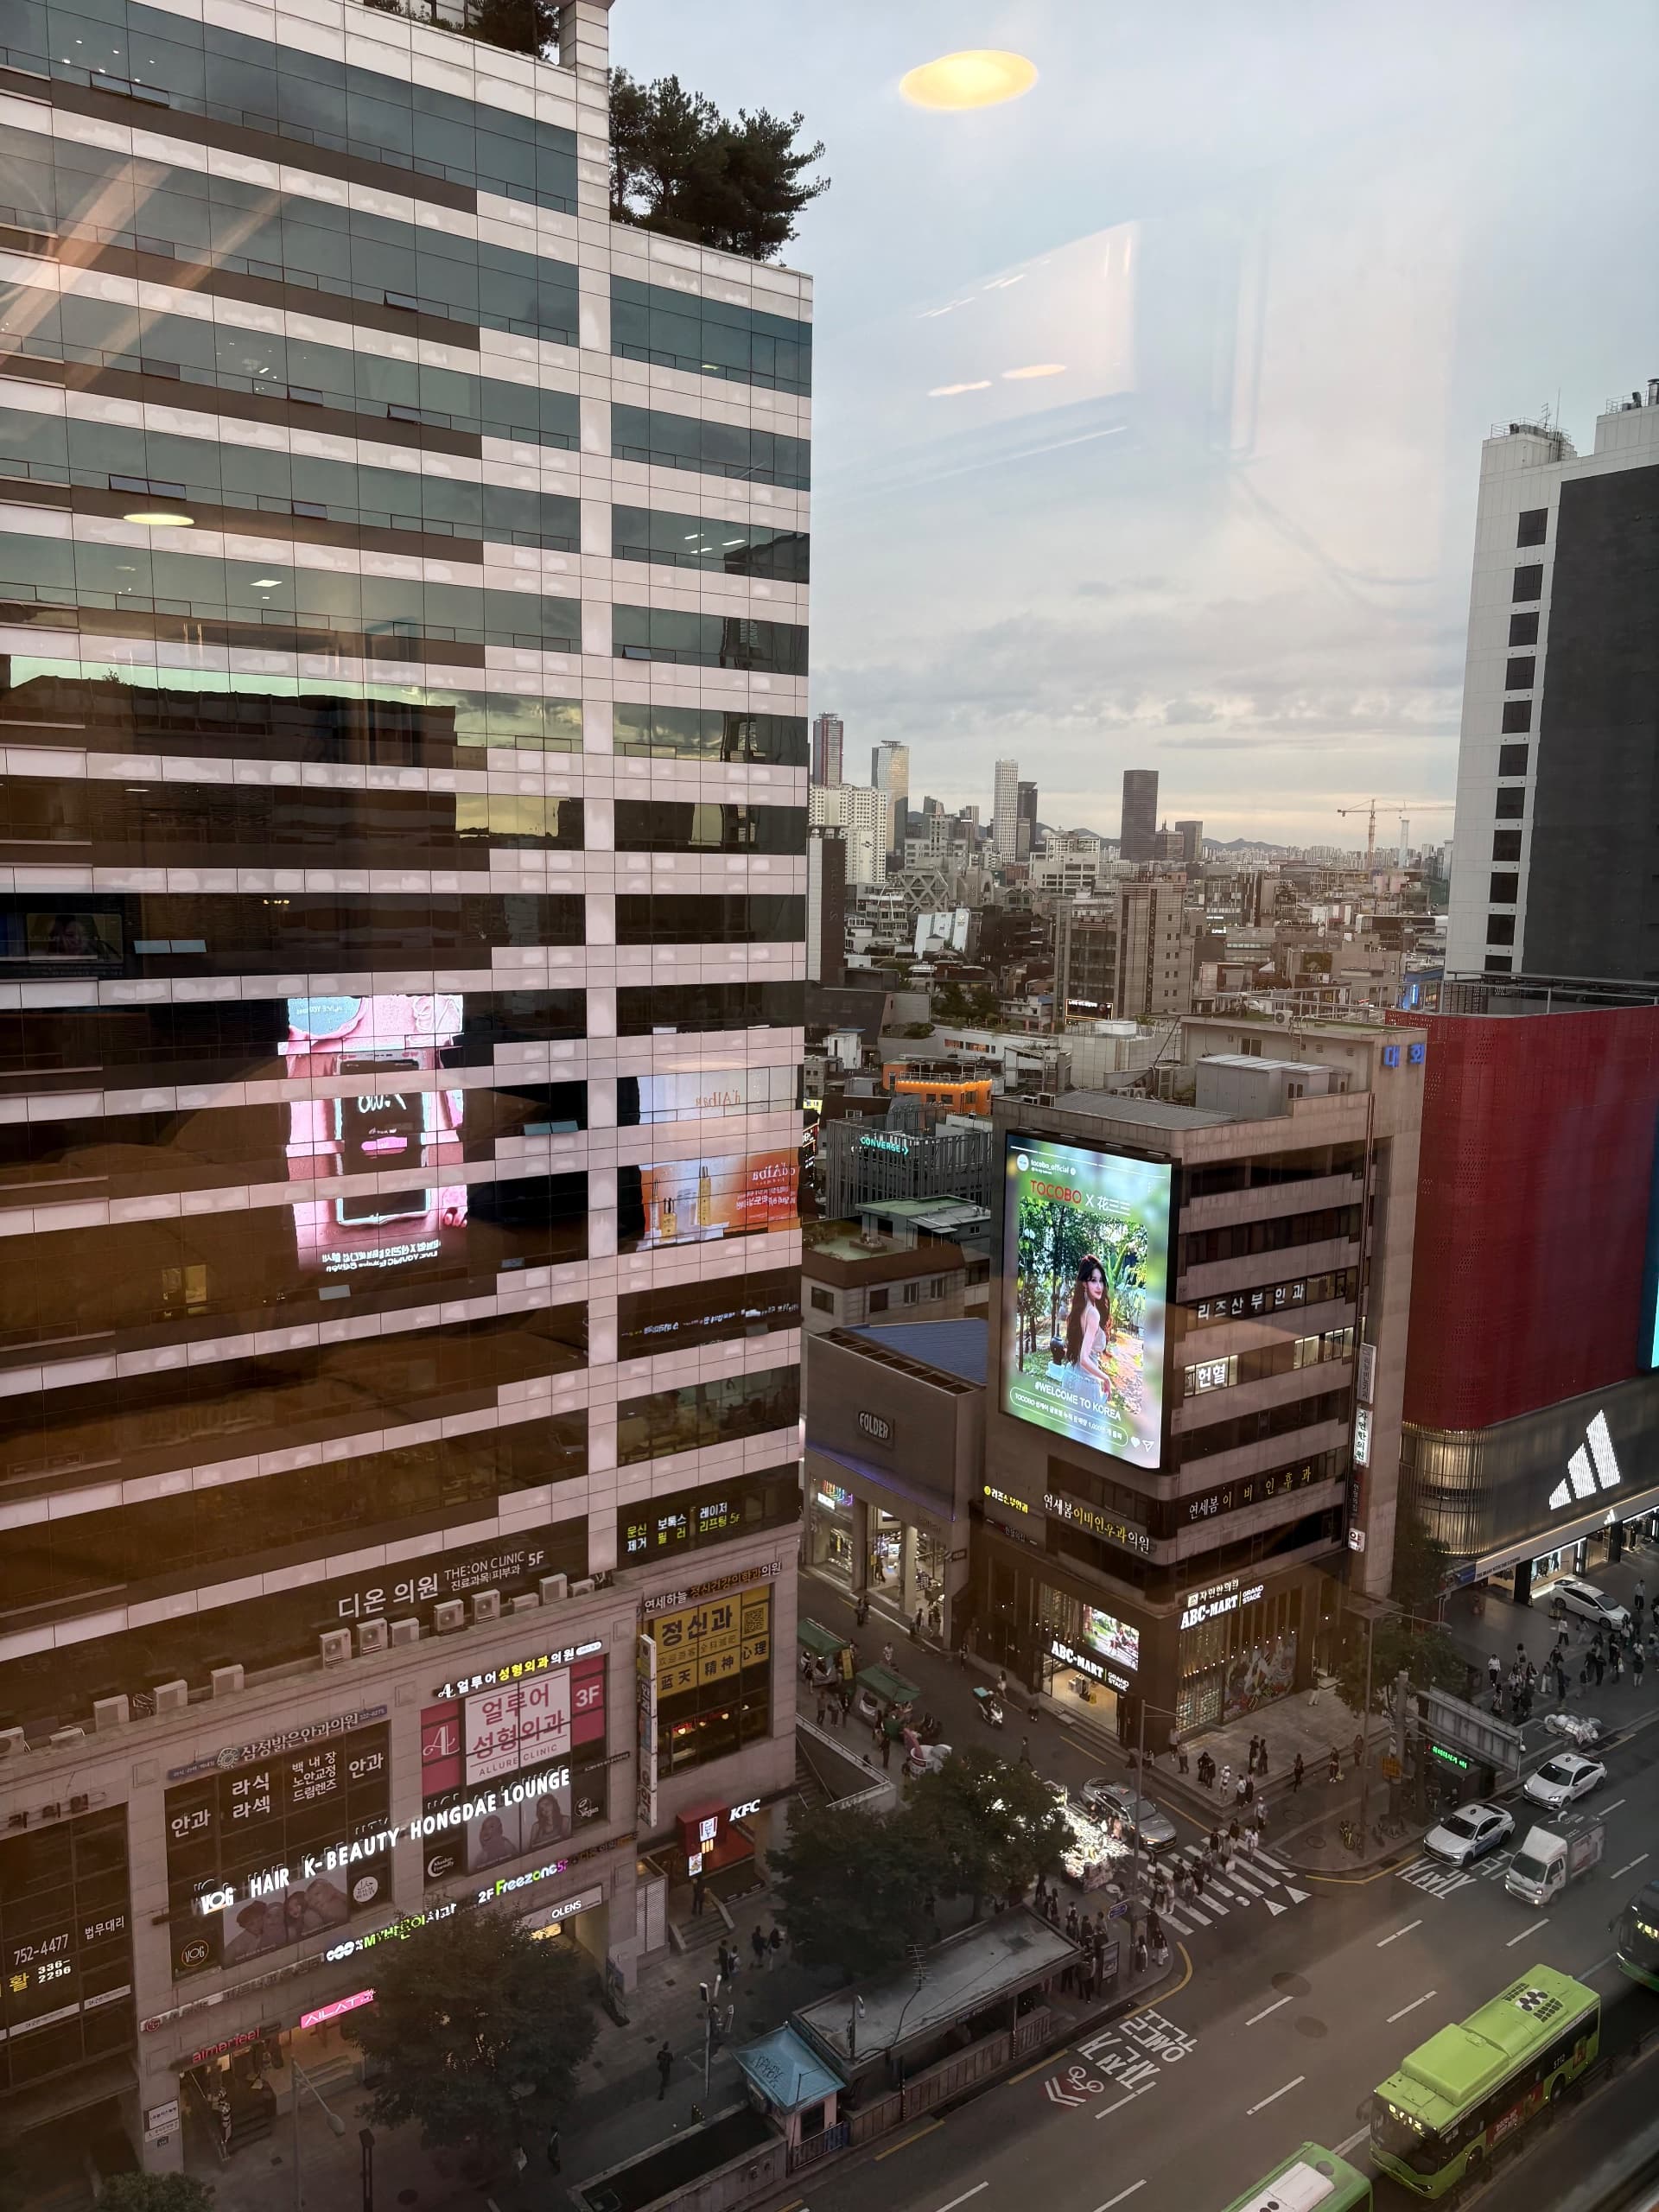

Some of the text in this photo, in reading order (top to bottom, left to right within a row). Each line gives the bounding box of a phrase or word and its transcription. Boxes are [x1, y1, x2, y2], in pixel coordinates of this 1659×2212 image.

[860, 1135, 901, 1153] CONVERSE
[1030, 1179, 1082, 1205] TOCOBO
[1084, 1193, 1095, 1208] X
[1197, 1283, 1306, 1322] 리즈산부인과
[1198, 1363, 1227, 1387] 헌혈
[1079, 1396, 1091, 1409] TO
[1091, 1402, 1122, 1421] KOREA
[858, 1411, 889, 1439] FOLDER
[1188, 1465, 1312, 1521] 연세봄 이비인후과
[658, 1514, 687, 1530] 보톡스
[700, 1503, 728, 1518] 레이저
[1044, 1492, 1150, 1554] 연세봄이비인후과의원
[626, 1523, 647, 1539] 문신
[699, 1516, 728, 1533] 리프팅
[626, 1537, 647, 1553] 제거
[443, 1550, 545, 1581] THE:ON CLINIC 5F
[492, 1564, 522, 1580] 피부과
[338, 1573, 439, 1618] 디온 의원
[644, 1590, 688, 1612] 연세하늘
[1242, 1592, 1262, 1605] STAGE
[1243, 1585, 1264, 1598] GRAND
[1179, 1594, 1238, 1630] ABC-MART
[662, 1604, 733, 1647] 정신과
[704, 1656, 734, 1676] 精神
[741, 1640, 766, 1661] 心理
[1051, 1640, 1103, 1679] ABC-MART
[1107, 1671, 1129, 1687] GRAND
[1107, 1677, 1128, 1692] STAGE
[481, 1683, 550, 1726] 얼루어
[575, 1685, 600, 1707] 3F
[473, 1710, 564, 1760] 성형외과
[291, 1751, 338, 1774] 백내장
[348, 1752, 385, 1779] 안과
[479, 1744, 557, 1777] ALLURE CLINIC
[232, 1772, 270, 1796] 라식
[291, 1764, 337, 1789] 노안교정
[292, 1778, 338, 1802] 드림렌즈
[232, 1795, 270, 1819] 라섹
[729, 1798, 760, 1822] KFC
[171, 1808, 212, 1839] 안과
[200, 1768, 570, 1916] VOG HAIR K-BEAUTY HONGDAE LOUNGE
[478, 1887, 494, 1904] 2F
[495, 1865, 557, 1897] Freezone
[1394, 1857, 1478, 1900] 자전거
[551, 1901, 582, 1919] OLENS
[85, 1915, 125, 1941] 법무대리
[13, 1934, 69, 1966] 752-4477
[185, 1944, 206, 1963] VOG
[38, 1966, 72, 1984] 2296
[192, 2027, 260, 2063] aimerfeel
[1118, 2009, 1198, 2063] 우선도로
[1077, 2031, 1161, 2089] 자전거
